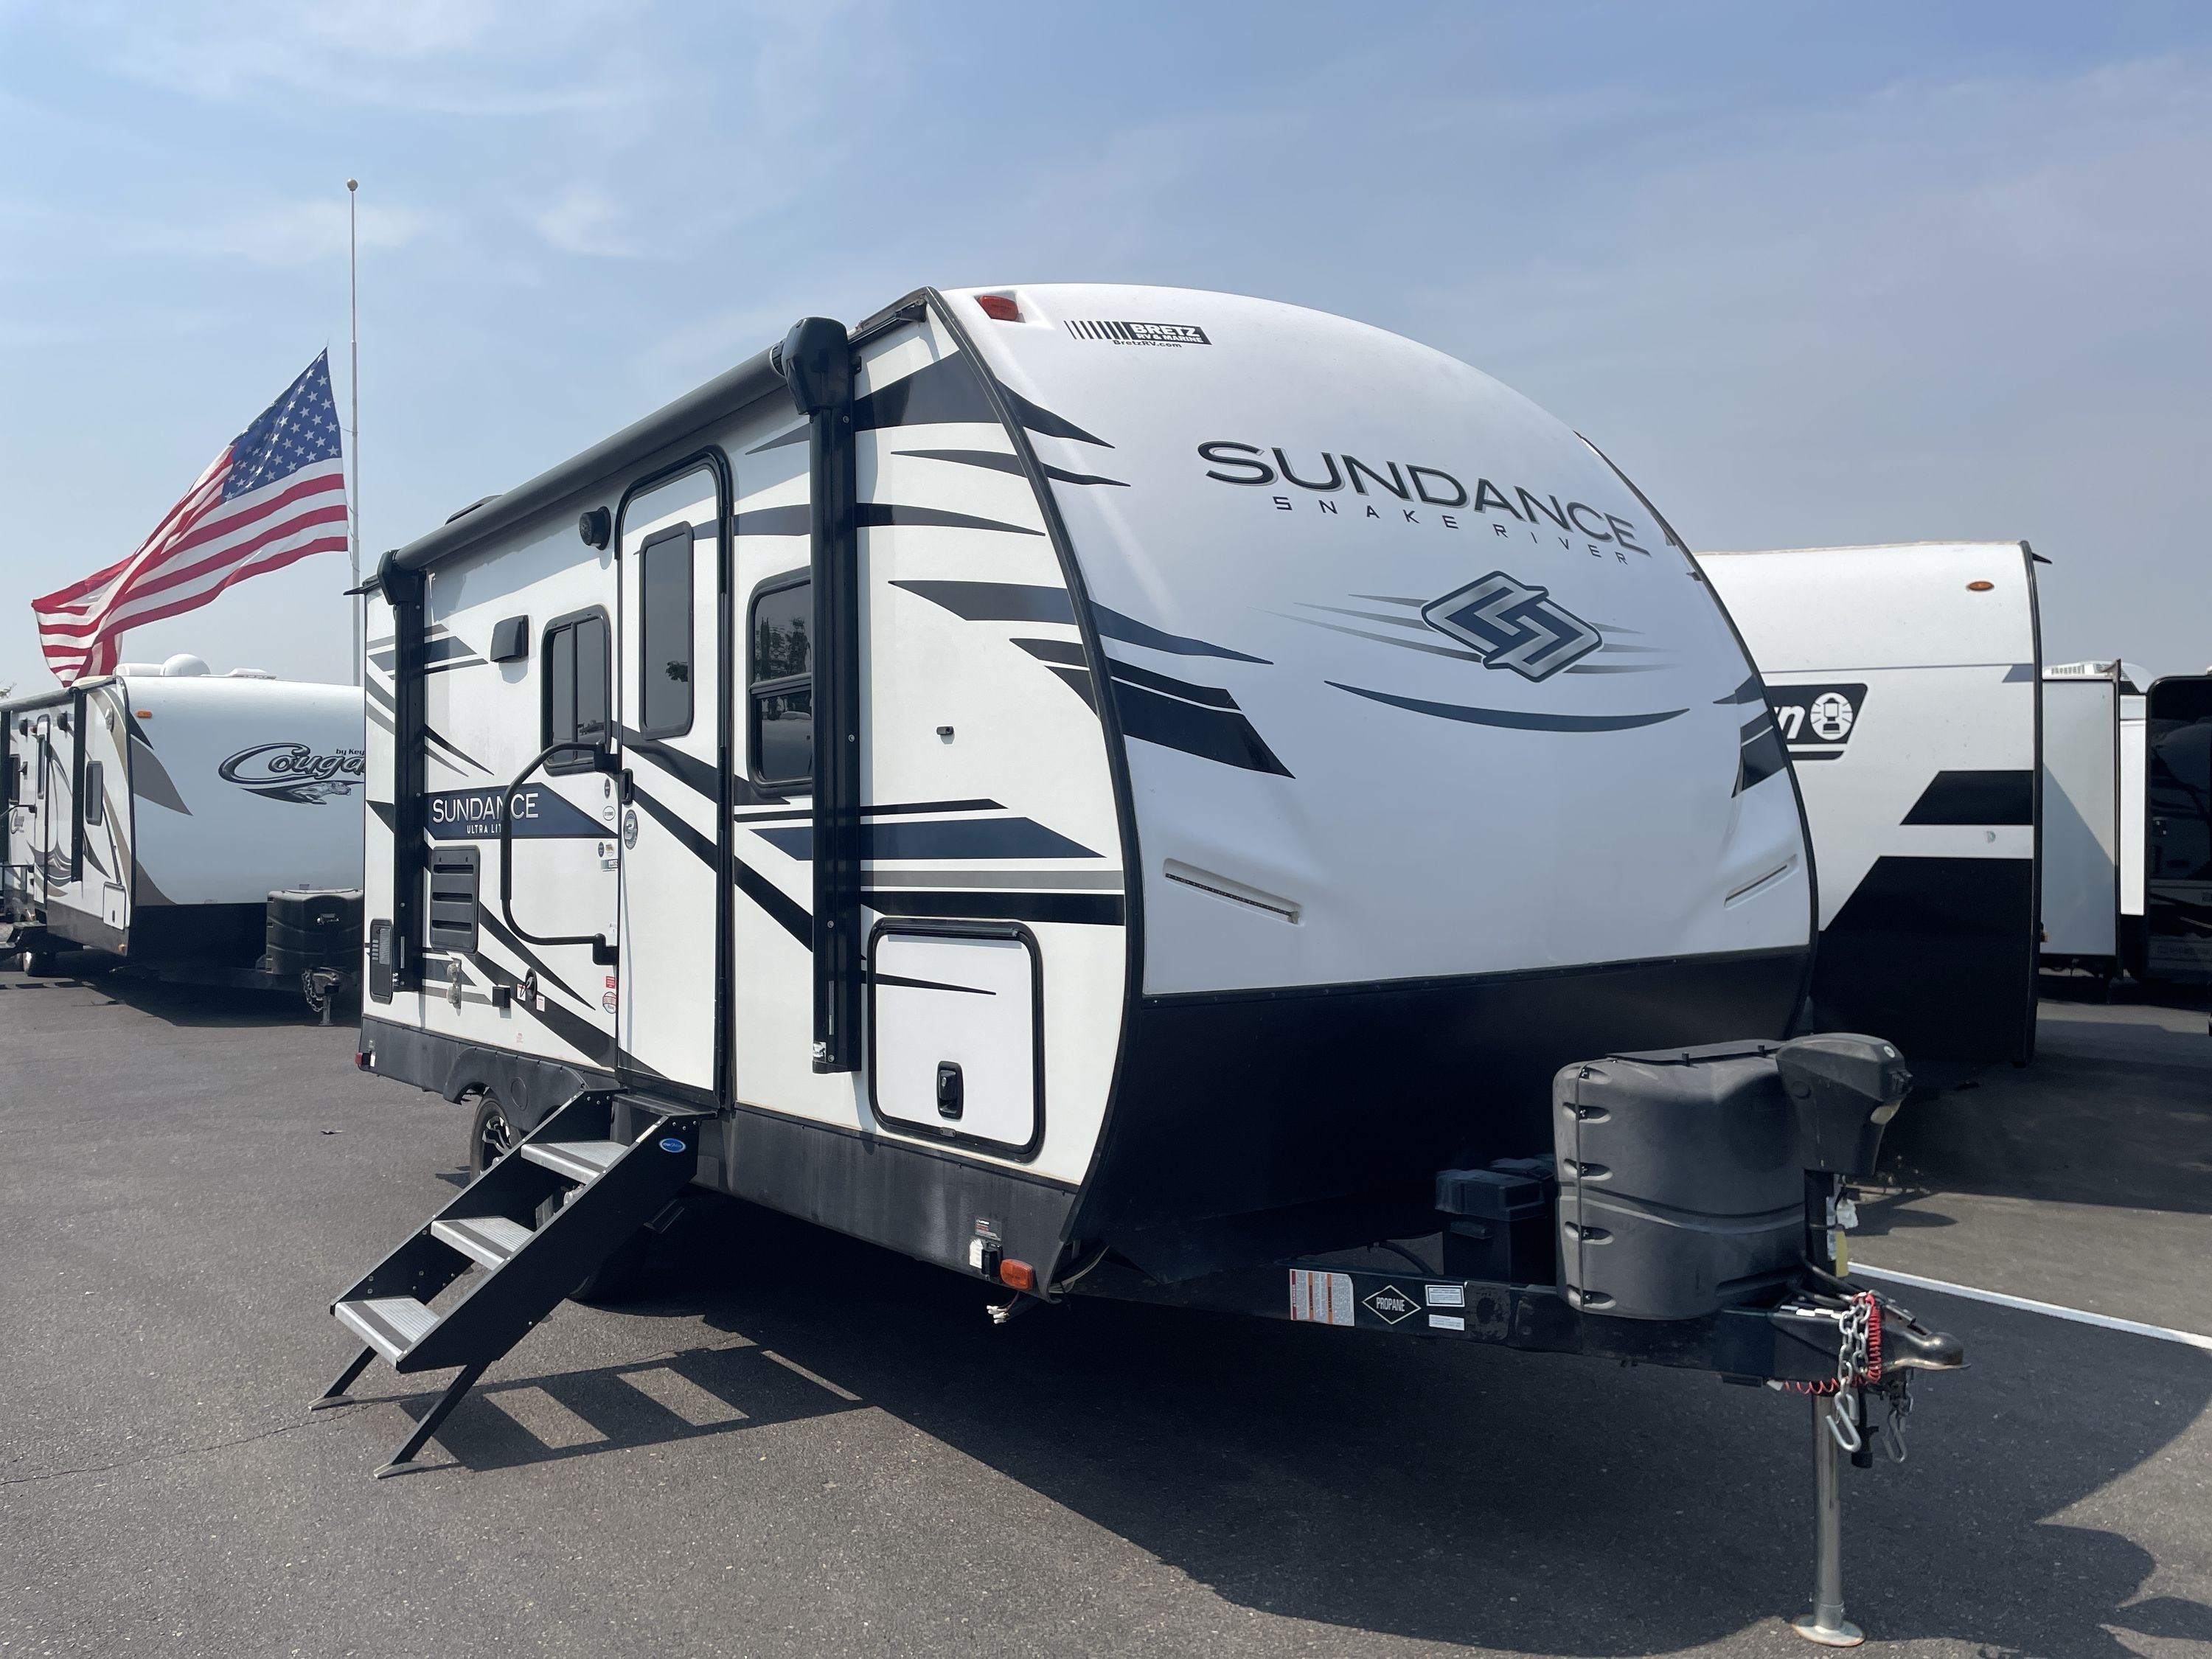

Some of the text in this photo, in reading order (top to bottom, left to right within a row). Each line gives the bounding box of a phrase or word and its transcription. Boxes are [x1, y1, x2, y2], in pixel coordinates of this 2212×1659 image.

[1130, 324, 1200, 338] BRETZ
[1162, 334, 1204, 343] MARINE
[1112, 340, 1183, 348] BretzRV.com
[1197, 440, 1652, 557] SUNDANCE
[1273, 495, 1629, 566] SNAKE RIVER
[218, 742, 365, 785] Couga
[466, 824, 488, 834] ULTRA
[1376, 1296, 1405, 1312] PROPANE
